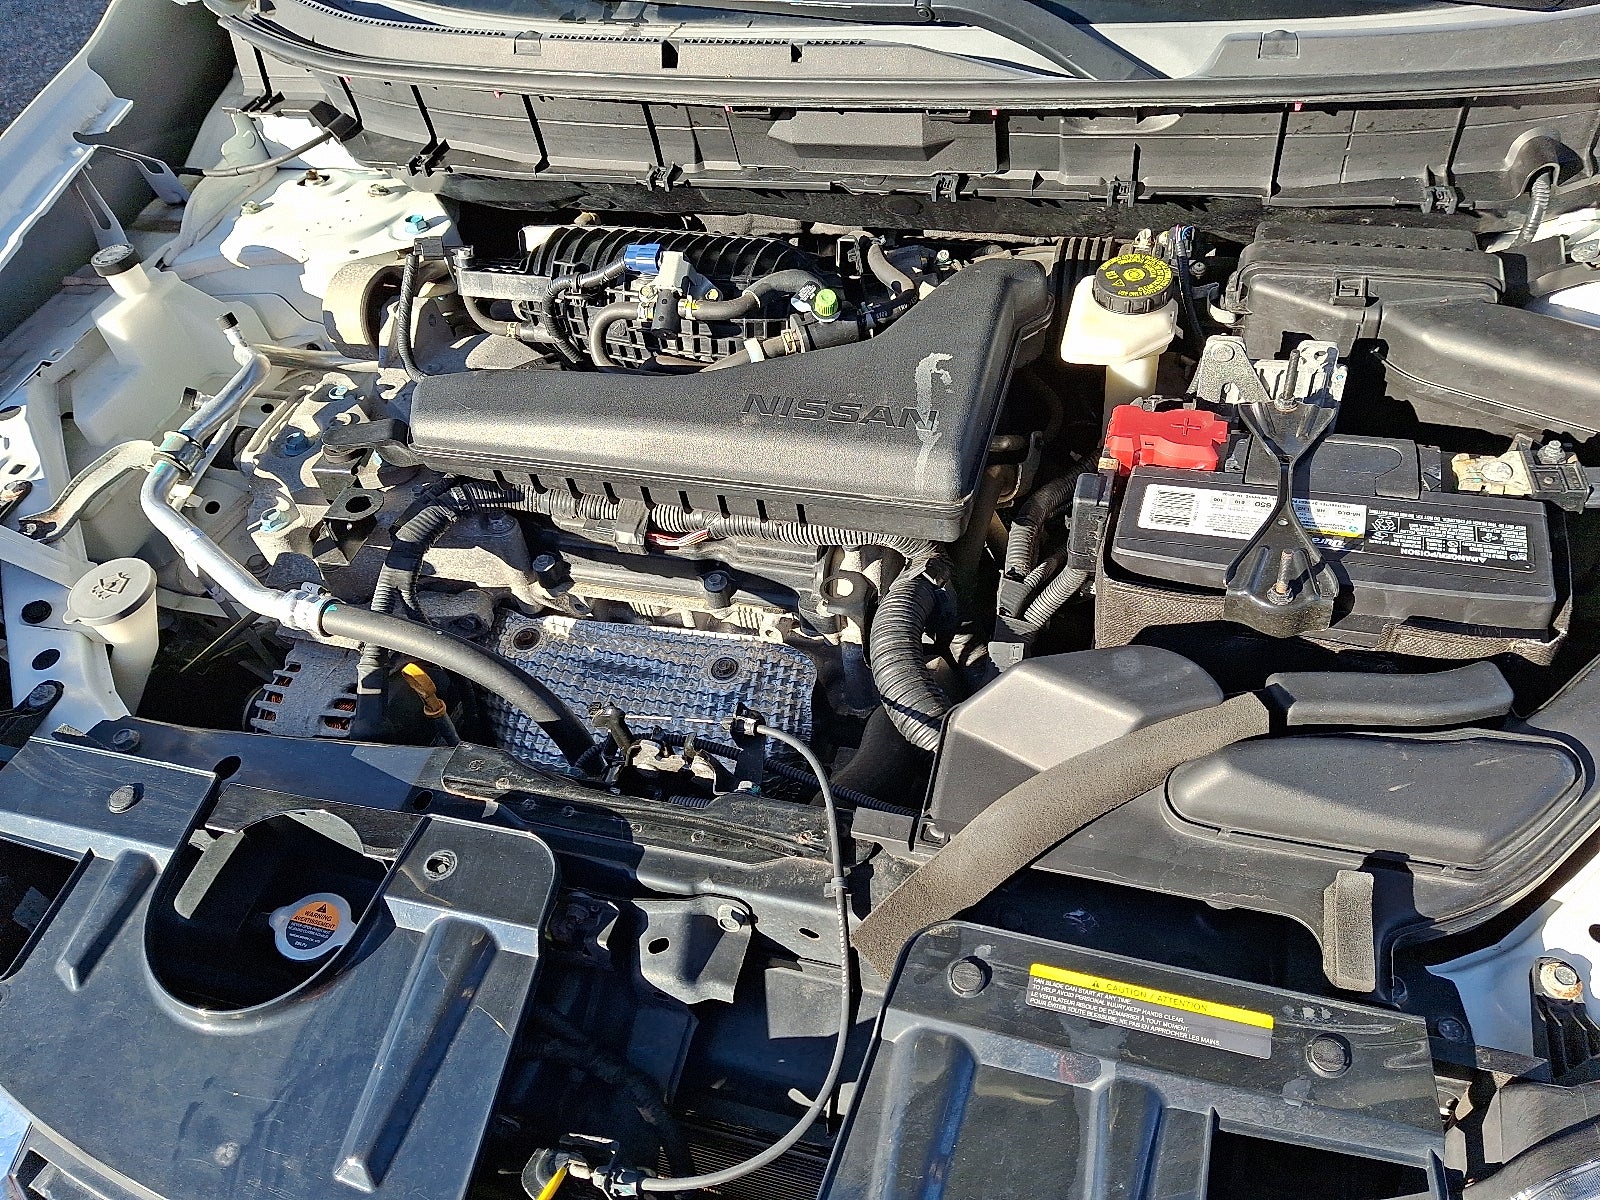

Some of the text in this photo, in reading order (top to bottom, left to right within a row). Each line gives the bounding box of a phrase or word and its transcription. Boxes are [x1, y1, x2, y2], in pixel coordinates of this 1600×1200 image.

[741, 392, 940, 432] NISSAN
[305, 911, 332, 921] WARNING
[1040, 985, 1056, 993] HELP
[1056, 989, 1074, 998] AVOID
[1074, 993, 1105, 1005] PERSONAL
[1141, 1008, 1163, 1018] HANDS
[1163, 1013, 1185, 1023] CLEAR.
[1064, 984, 1077, 992] CAN
[1077, 987, 1096, 996] START
[1107, 984, 1147, 998] CAUTION
[1157, 994, 1208, 1011] ATTENTION
[1030, 997, 1047, 1005] POUR
[1067, 1006, 1086, 1015] TOUTE
[1150, 1025, 1187, 1038] APPROCHER
[1200, 1036, 1222, 1046] MAINS.
[1038, 992, 1075, 1006] VENTILATEUR
[1075, 1001, 1098, 1011] RISQUE
[1107, 1007, 1140, 1021] DÉMARRER
[1144, 1017, 1161, 1025] TOUT
[1162, 1021, 1190, 1032] MOMENT.
